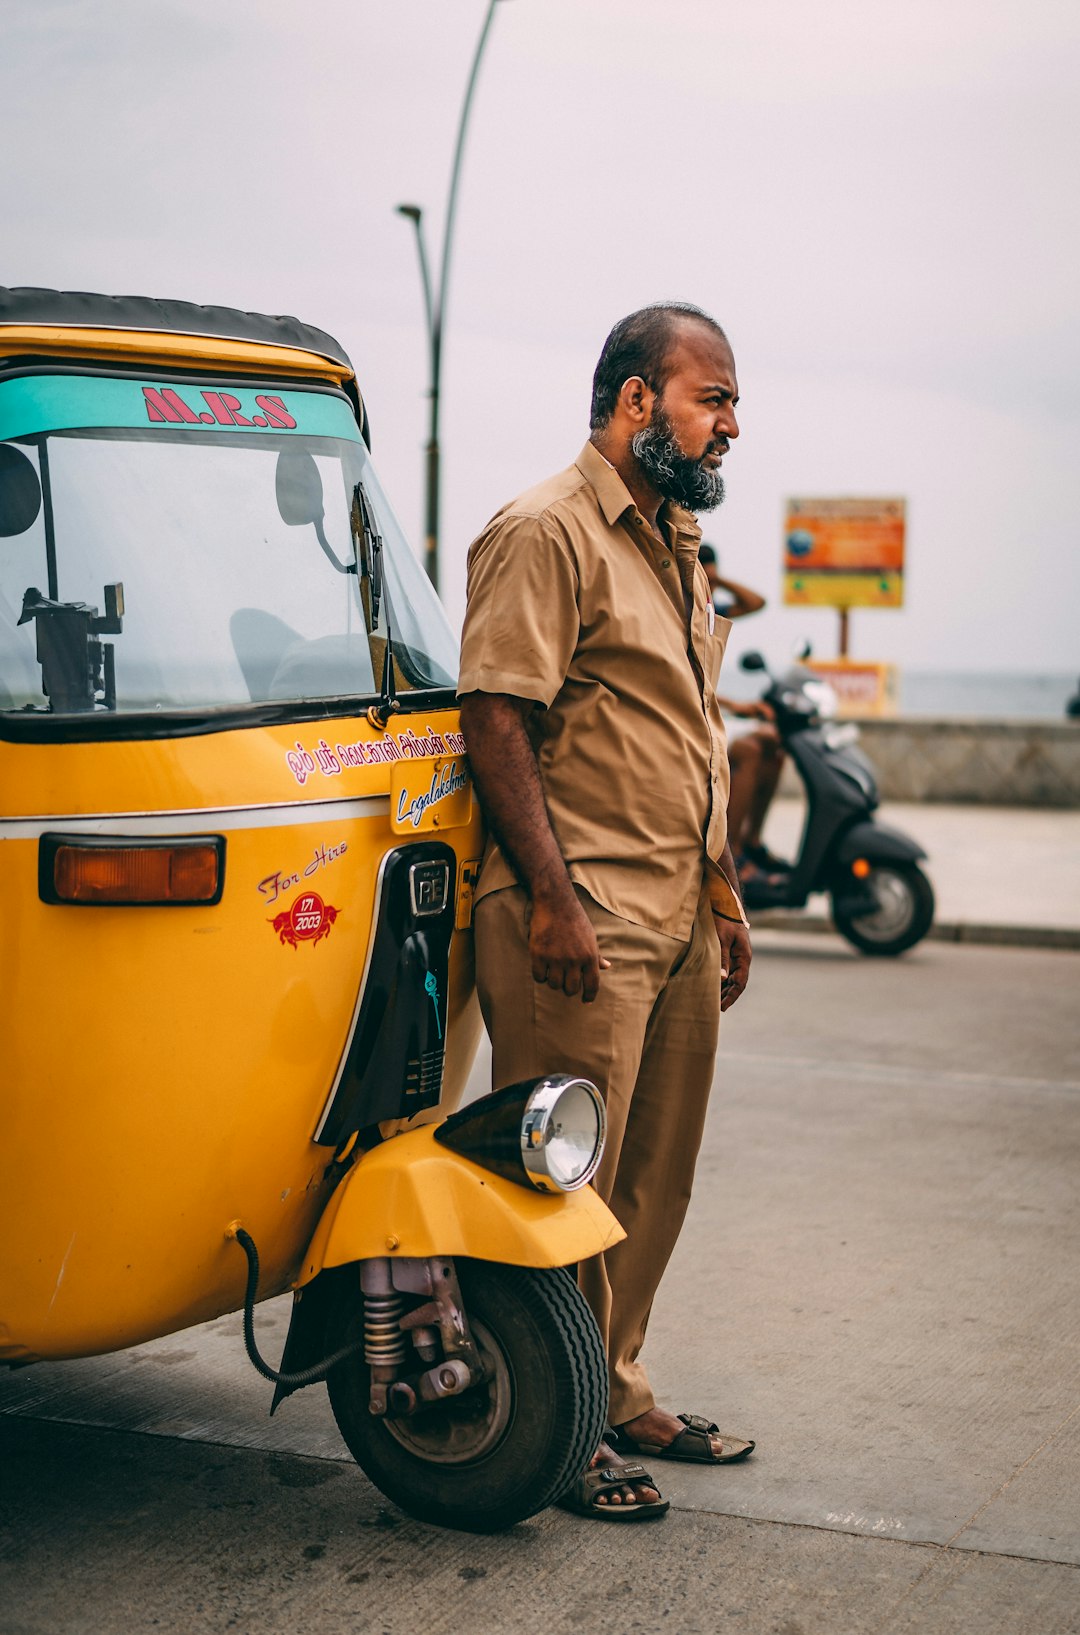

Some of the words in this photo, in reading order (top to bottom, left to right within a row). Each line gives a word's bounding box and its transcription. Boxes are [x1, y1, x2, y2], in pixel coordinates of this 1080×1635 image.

[141, 387, 297, 429] M.R.S
[287, 742, 315, 784] ஓம்
[399, 727, 448, 758] அம்மன்
[258, 870, 299, 904] For
[304, 843, 348, 876] Hire
[296, 915, 321, 930] 2003
[301, 898, 314, 911] 171
